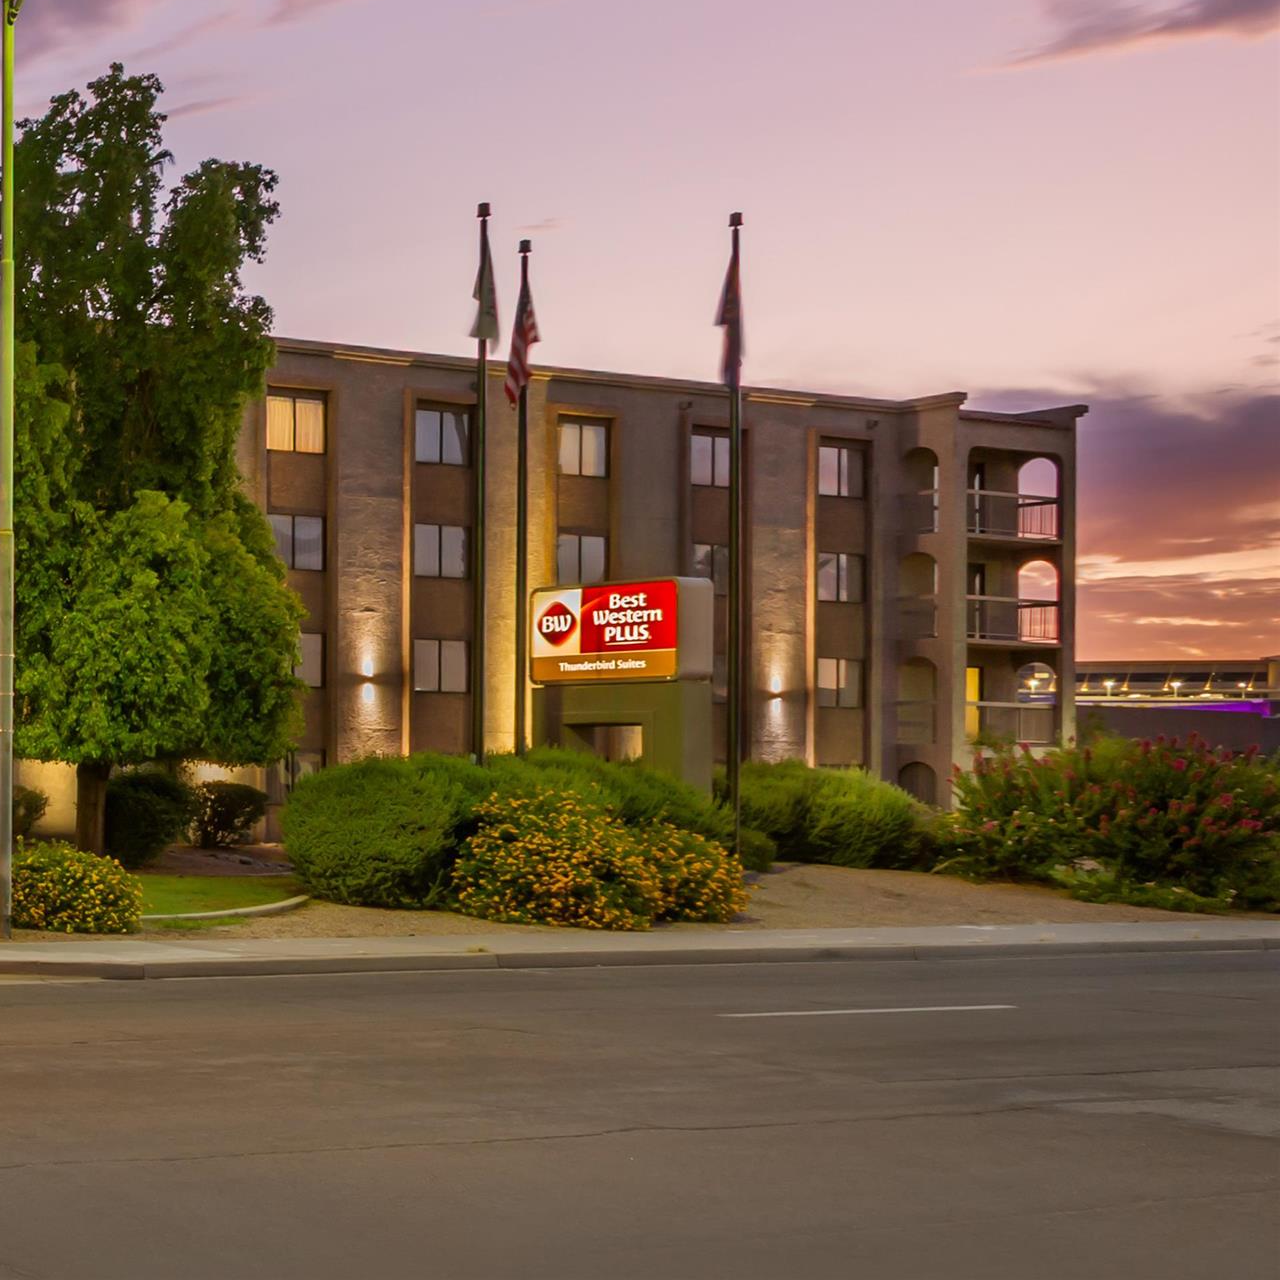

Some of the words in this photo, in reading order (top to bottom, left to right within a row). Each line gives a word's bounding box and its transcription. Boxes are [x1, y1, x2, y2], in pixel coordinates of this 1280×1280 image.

[609, 593, 647, 609] Best
[542, 614, 572, 633] BW
[593, 609, 663, 625] Western
[604, 625, 649, 642] PLUS
[559, 661, 615, 672] Thunderbird
[617, 659, 646, 669] Suites
